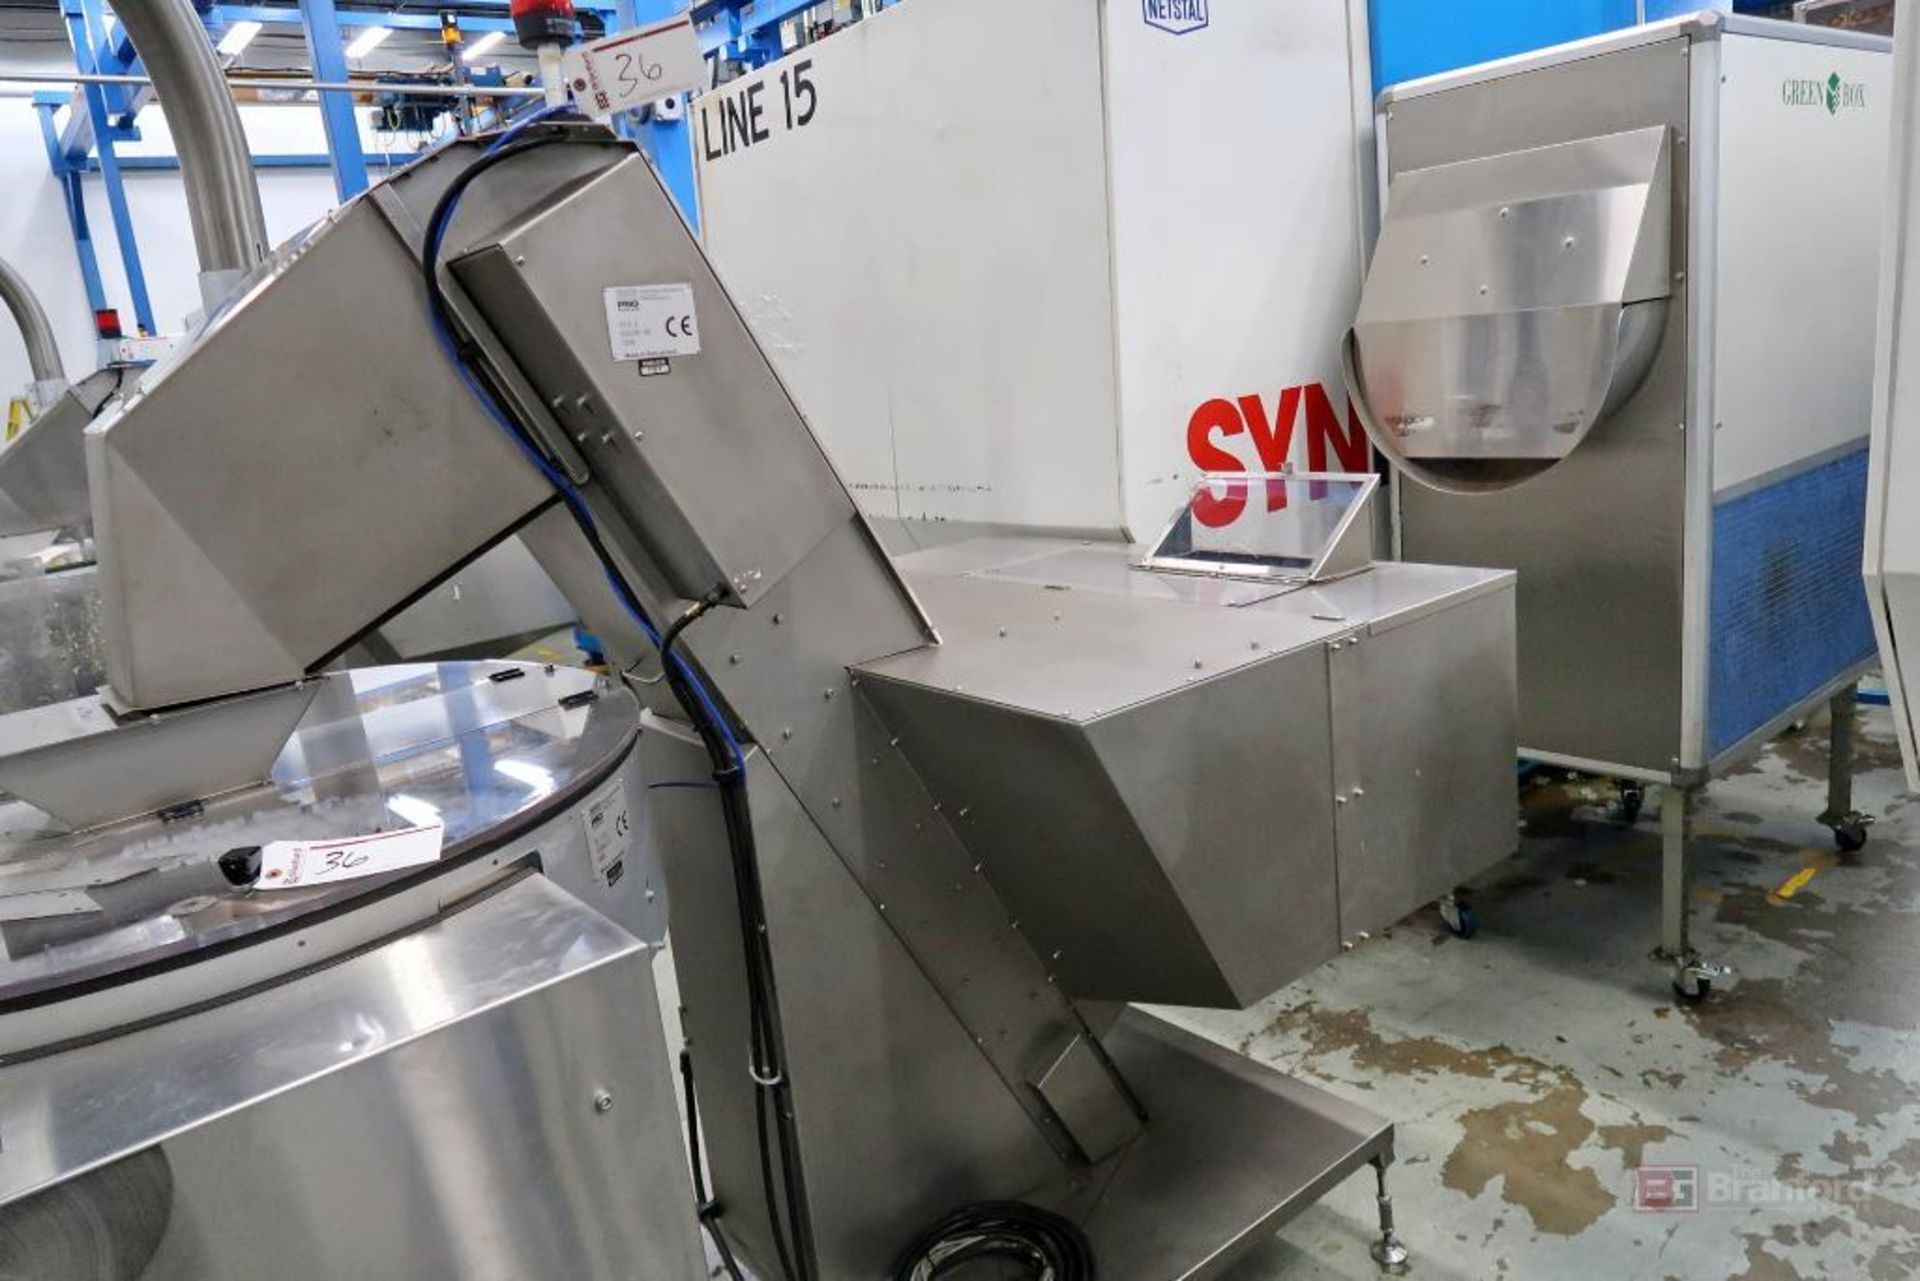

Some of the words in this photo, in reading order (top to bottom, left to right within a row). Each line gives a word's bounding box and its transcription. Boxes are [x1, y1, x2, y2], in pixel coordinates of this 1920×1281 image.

[1147, 0, 1205, 21] NETSTAL
[615, 53, 663, 98] 36
[1782, 79, 1823, 106] GREEN
[1842, 83, 1866, 107] BOX
[702, 80, 770, 162] LINE
[779, 59, 818, 130] 15
[1186, 382, 1370, 529] SYN
[315, 851, 370, 875] 36
